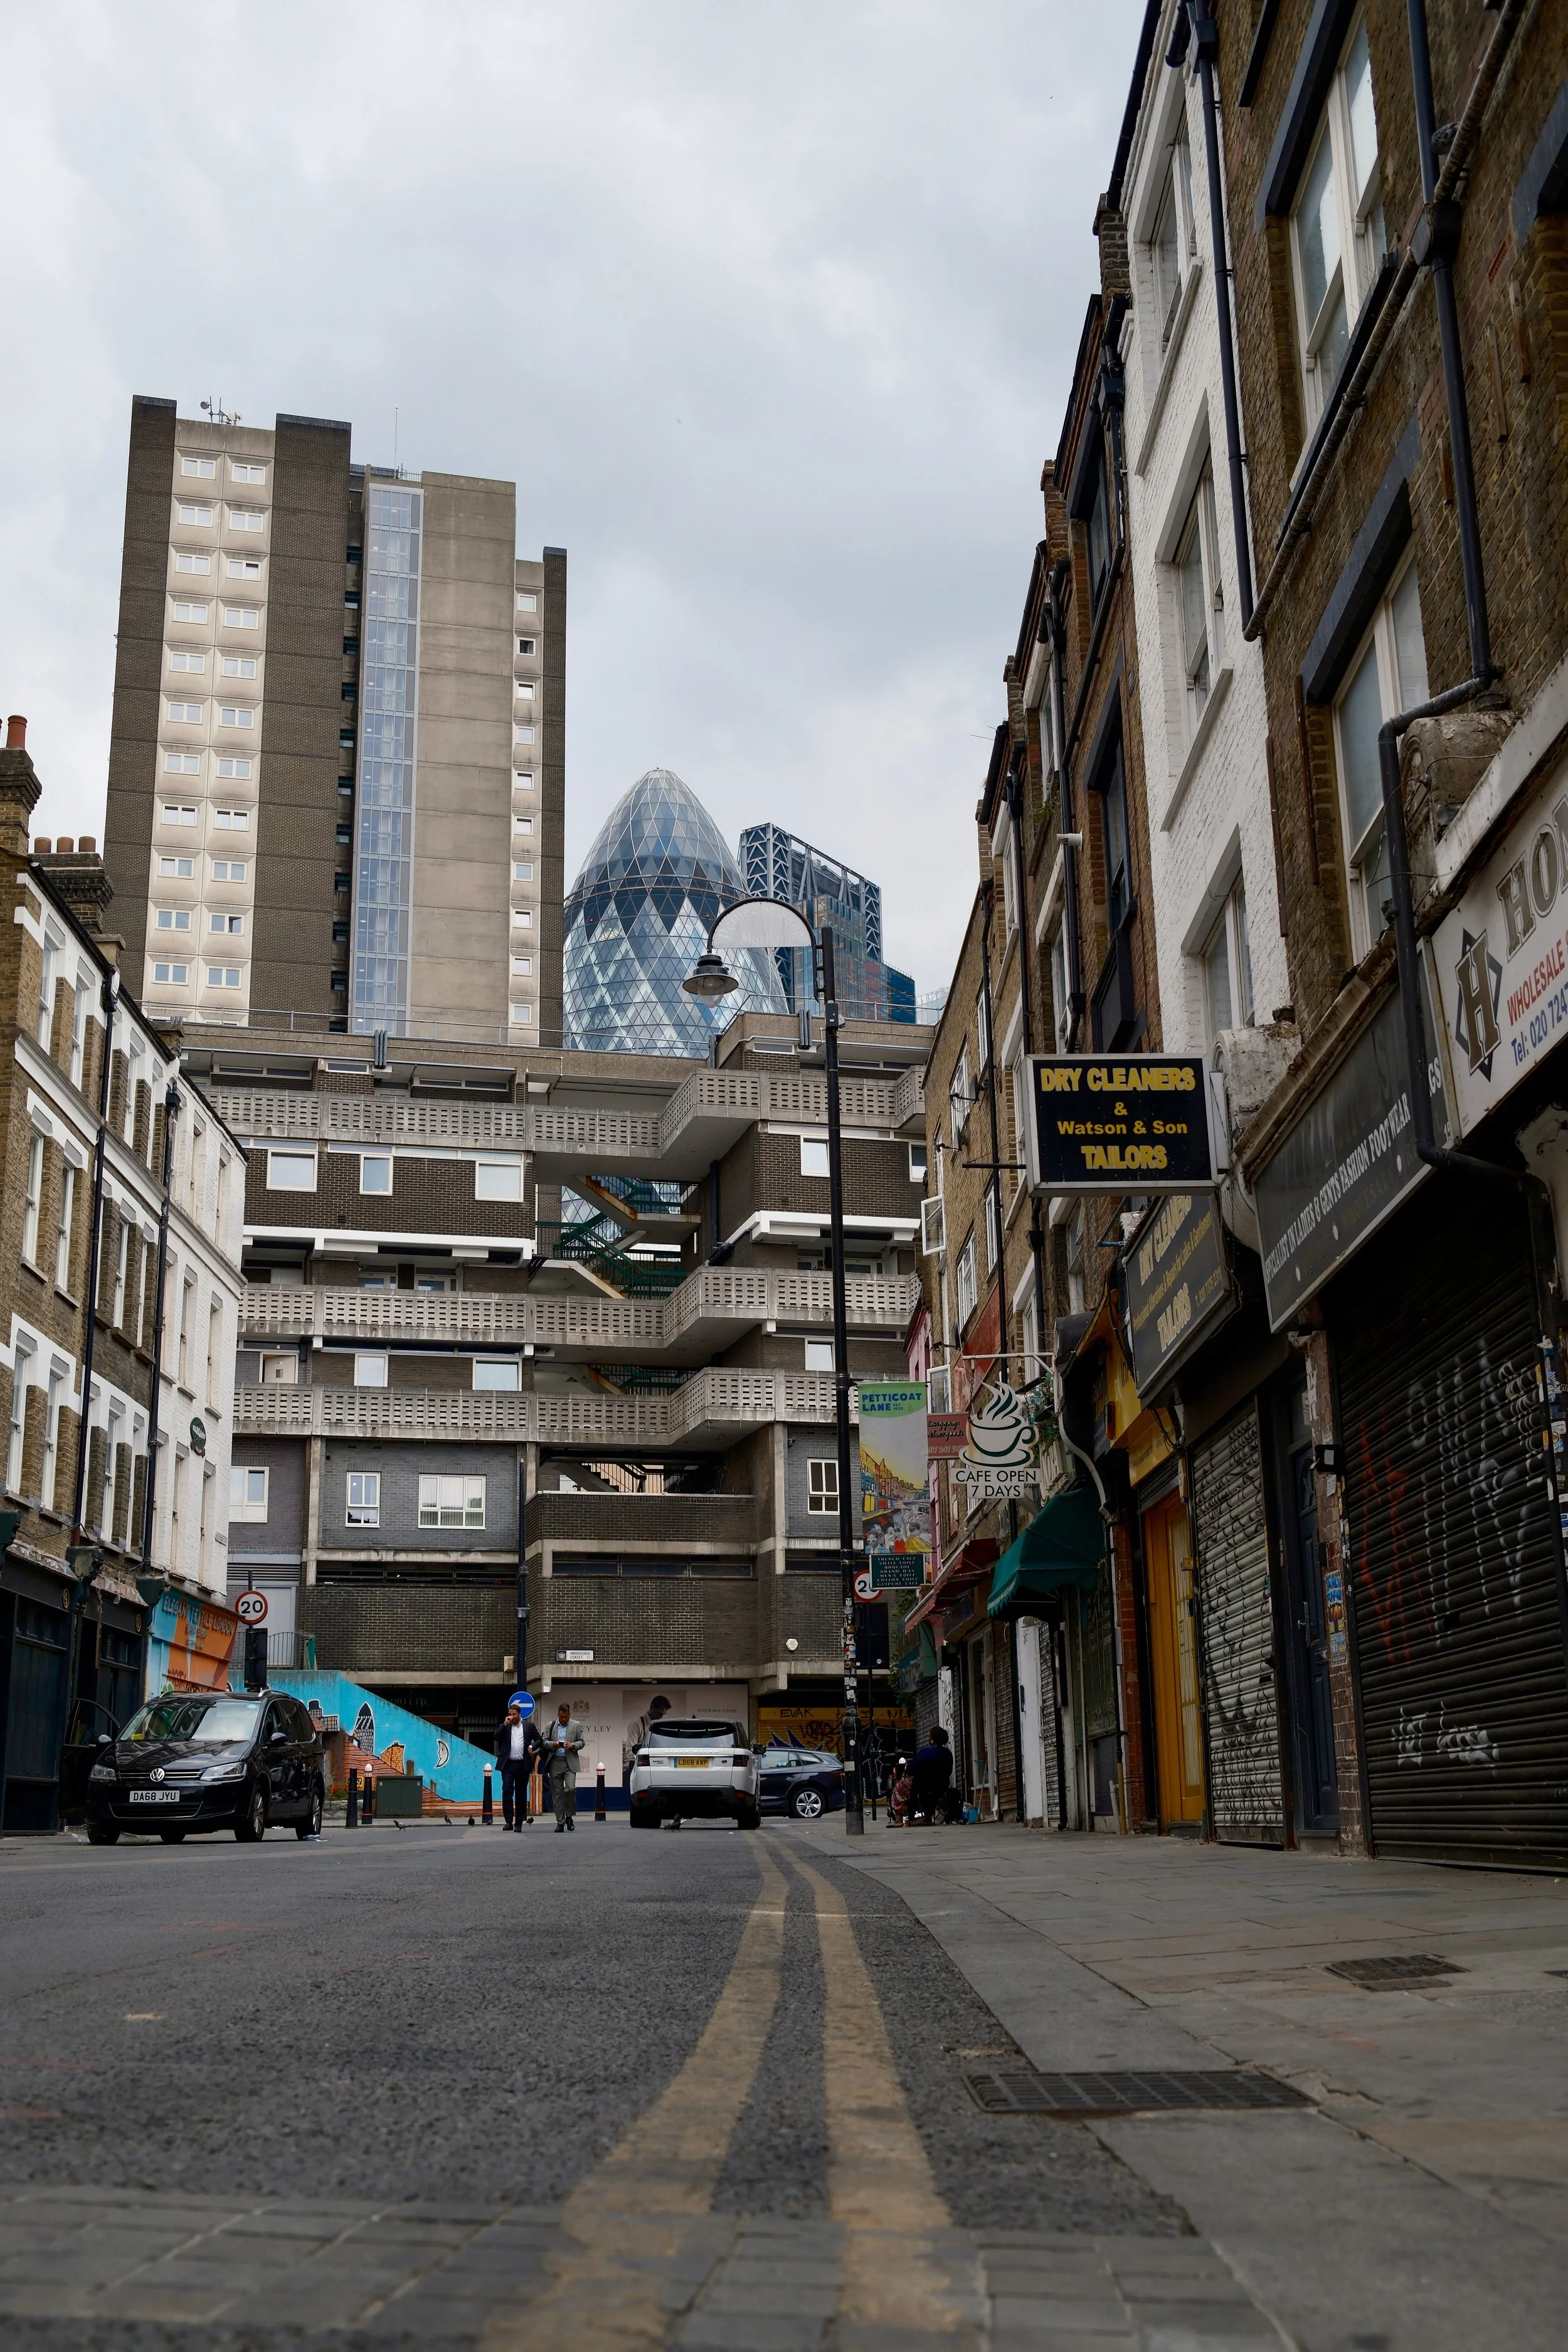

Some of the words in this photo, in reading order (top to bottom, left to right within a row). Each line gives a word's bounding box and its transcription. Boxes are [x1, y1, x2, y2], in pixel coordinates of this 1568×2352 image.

[741, 933, 784, 944] Market
[1507, 937, 1565, 1027] WHOLESALE
[1511, 1030, 1529, 1067] Tel:
[1530, 1008, 1548, 1049] 020
[1041, 1068, 1082, 1091] DRY
[1087, 1067, 1195, 1091] CLEANERS
[1114, 1101, 1128, 1116] &
[1057, 1121, 1126, 1135] Watson
[1133, 1120, 1147, 1134] &
[1153, 1120, 1188, 1134] Son
[1081, 1145, 1167, 1169] TAILORS
[1264, 1240, 1290, 1284] SPECIALIST
[1288, 1222, 1297, 1253] IN
[1293, 1204, 1316, 1246] LADIES
[1314, 1196, 1321, 1222] &
[1319, 1173, 1342, 1216] GENTS
[1338, 1138, 1370, 1193] FASHION
[1138, 1234, 1154, 1286] DRY
[1153, 1195, 1192, 1263] CLEANERS
[1157, 1282, 1191, 1353] TAILORS
[862, 1393, 922, 1402] PETTICOAT
[928, 1421, 961, 1431] Luggage
[928, 1429, 964, 1441] thergoods
[956, 1471, 991, 1482] CAFE
[997, 1470, 1036, 1482] OPEN
[972, 1485, 978, 1497] 7
[985, 1485, 1021, 1496] DAYS
[857, 1580, 877, 1592] 2
[241, 1600, 263, 1614] 20
[163, 1595, 191, 1619] ELEGANT
[213, 1614, 233, 1636] LONDON
[134, 1793, 156, 1801] DA68
[159, 1792, 176, 1800] JYU
